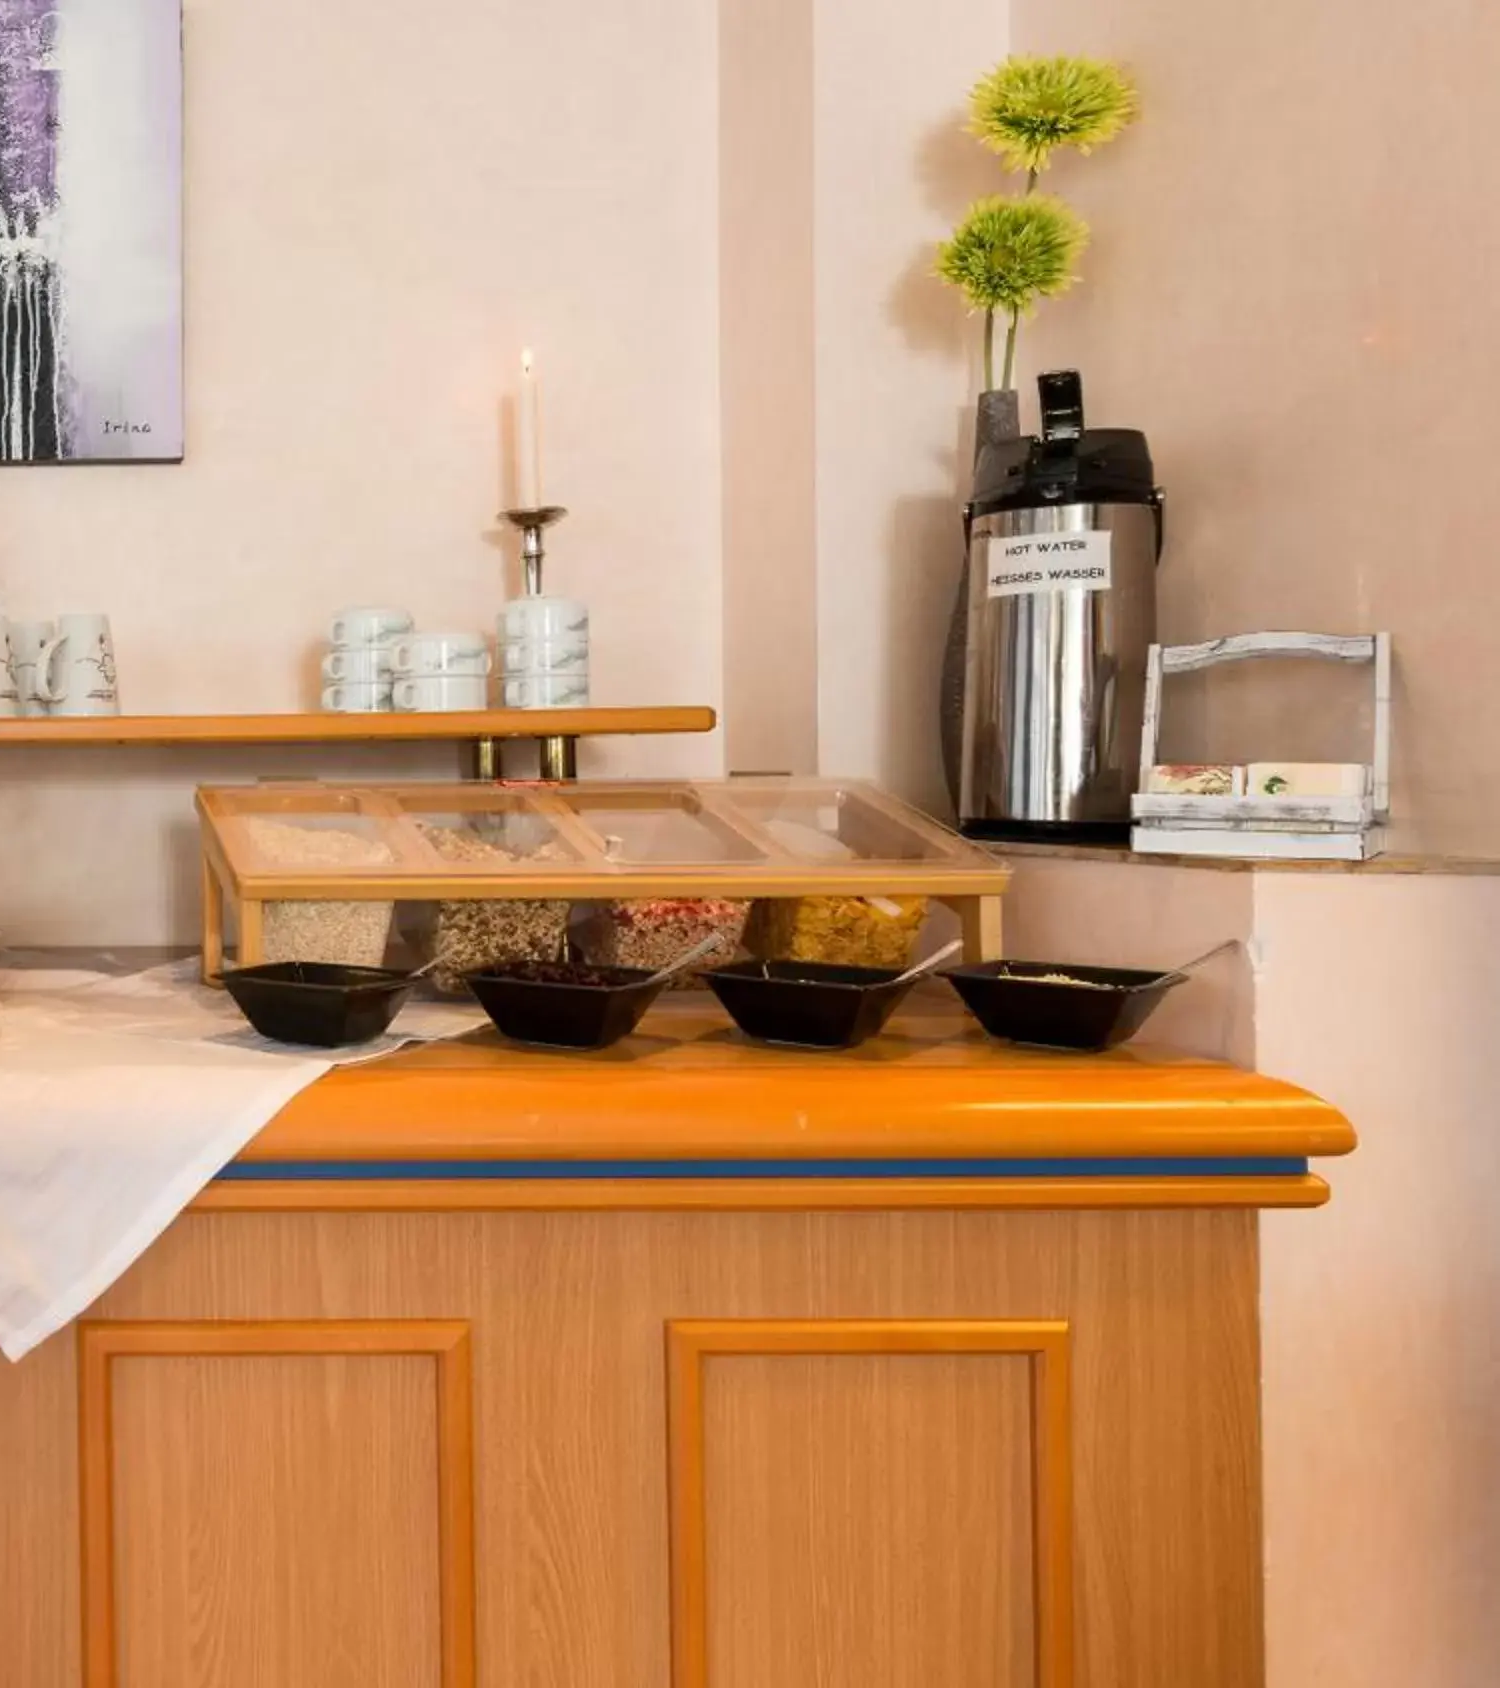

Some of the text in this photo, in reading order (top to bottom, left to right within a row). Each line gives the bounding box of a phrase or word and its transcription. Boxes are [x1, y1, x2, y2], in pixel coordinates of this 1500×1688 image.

[103, 420, 152, 434] Irina
[1005, 540, 1086, 557] HOT WATER
[1048, 567, 1105, 580] WASSER
